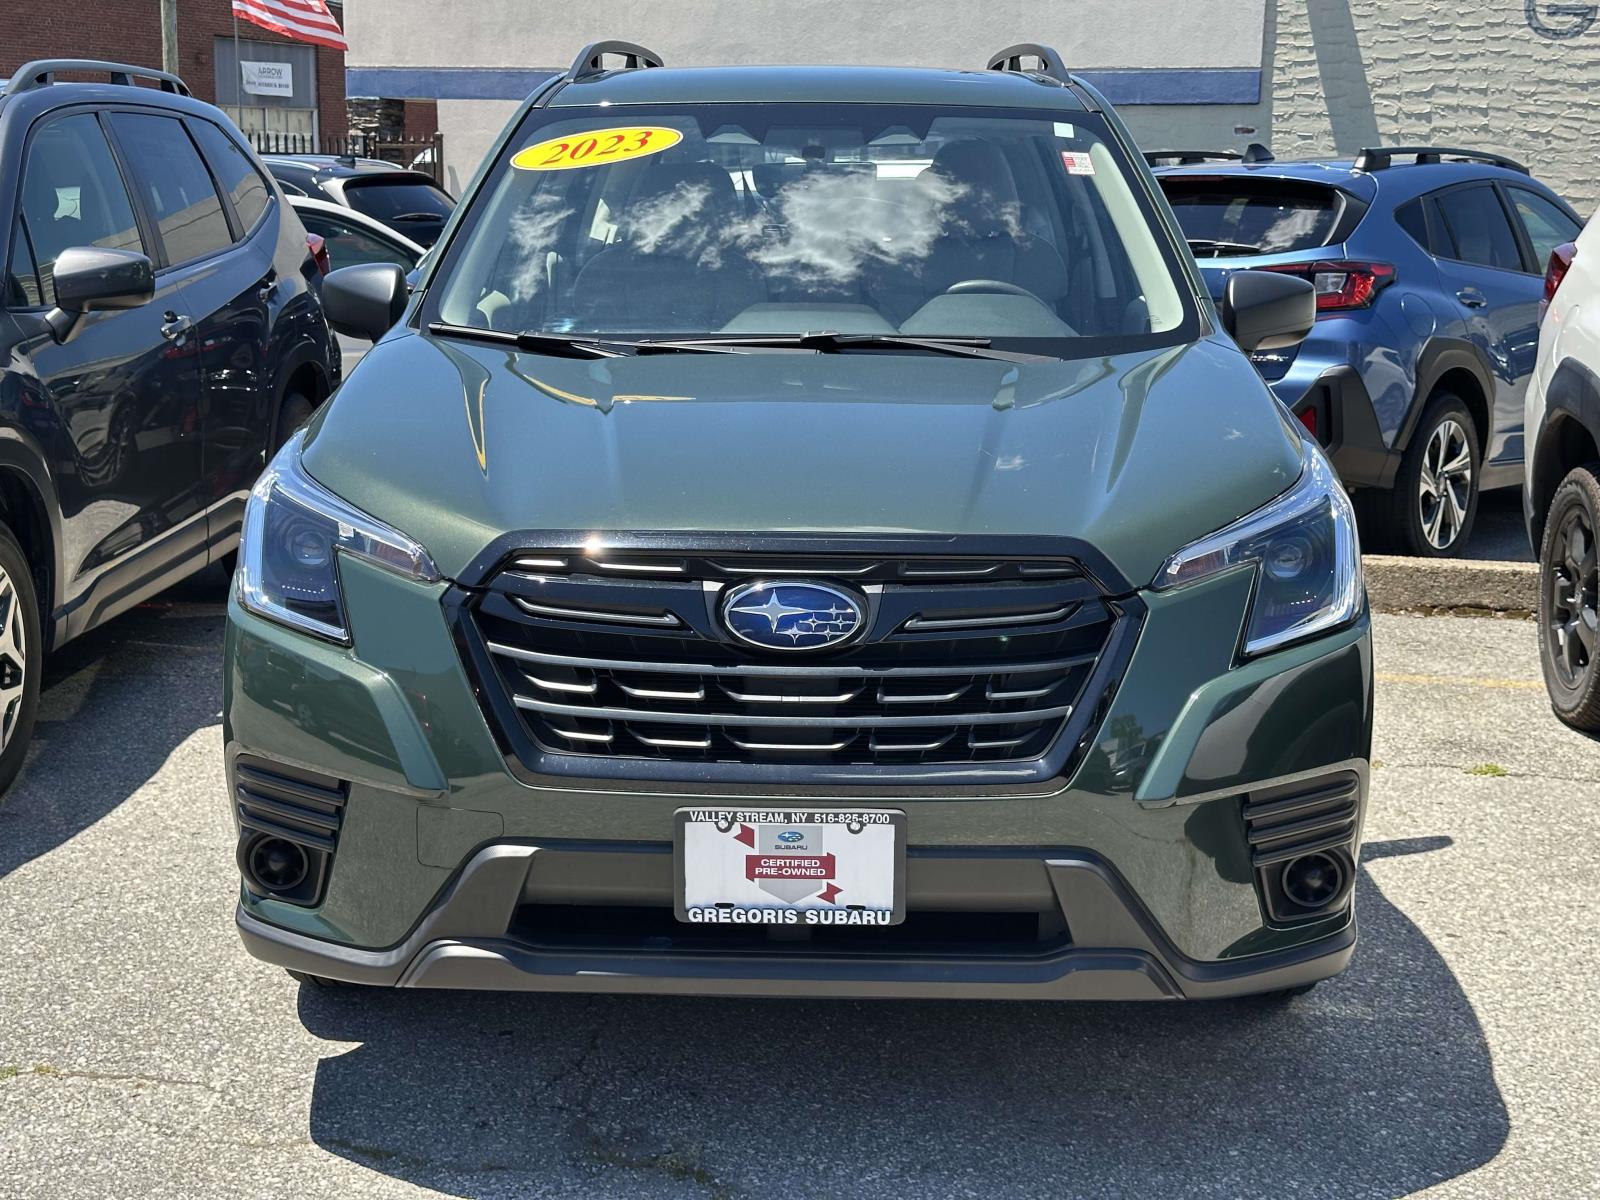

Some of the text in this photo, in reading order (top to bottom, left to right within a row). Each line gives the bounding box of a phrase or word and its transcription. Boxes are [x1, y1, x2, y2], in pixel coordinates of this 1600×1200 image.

[538, 131, 653, 166] 2023
[690, 811, 890, 824] VALLEY STREAM, NY 516-825-8700
[761, 859, 820, 867] CERTIFIED
[755, 868, 826, 876] PRE-OWNED
[688, 908, 891, 925] GREGORIS SUBARU
